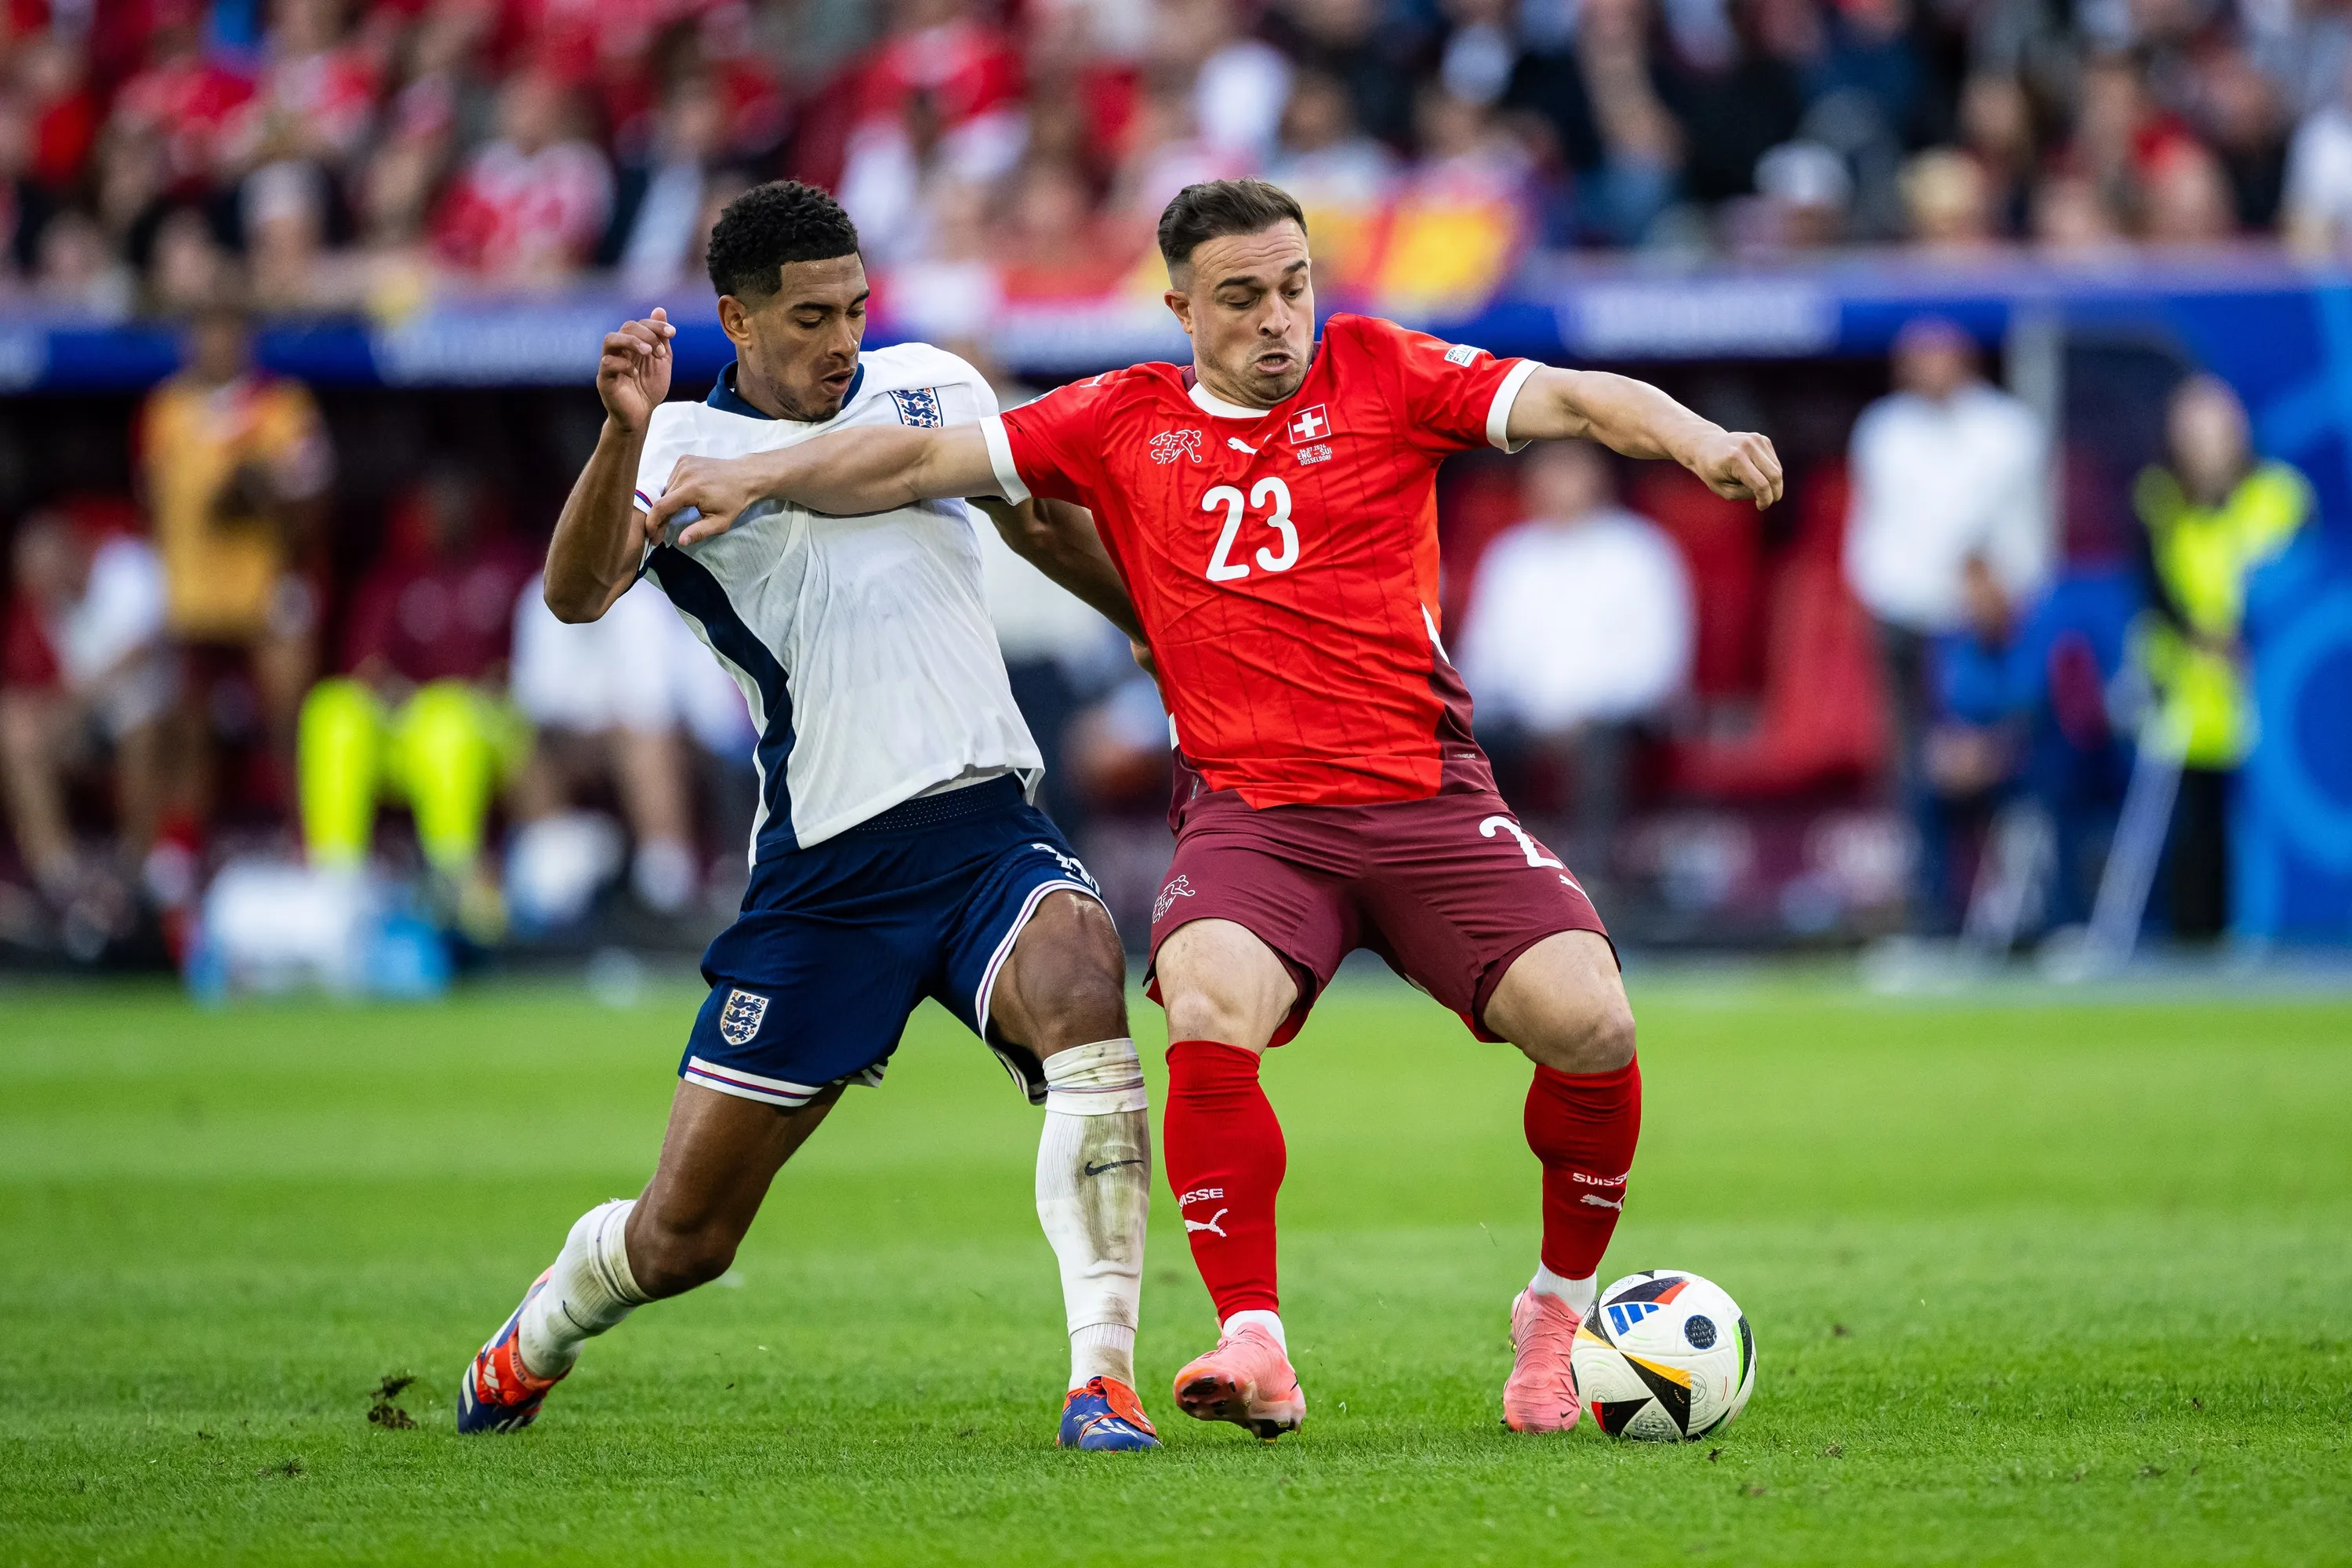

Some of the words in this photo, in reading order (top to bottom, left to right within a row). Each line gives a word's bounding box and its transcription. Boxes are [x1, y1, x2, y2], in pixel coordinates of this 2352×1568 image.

[1297, 452, 1312, 460] ENG
[1202, 477, 1299, 581] 23
[1479, 816, 1563, 869] 2
[1573, 1172, 1629, 1186] SUISS
